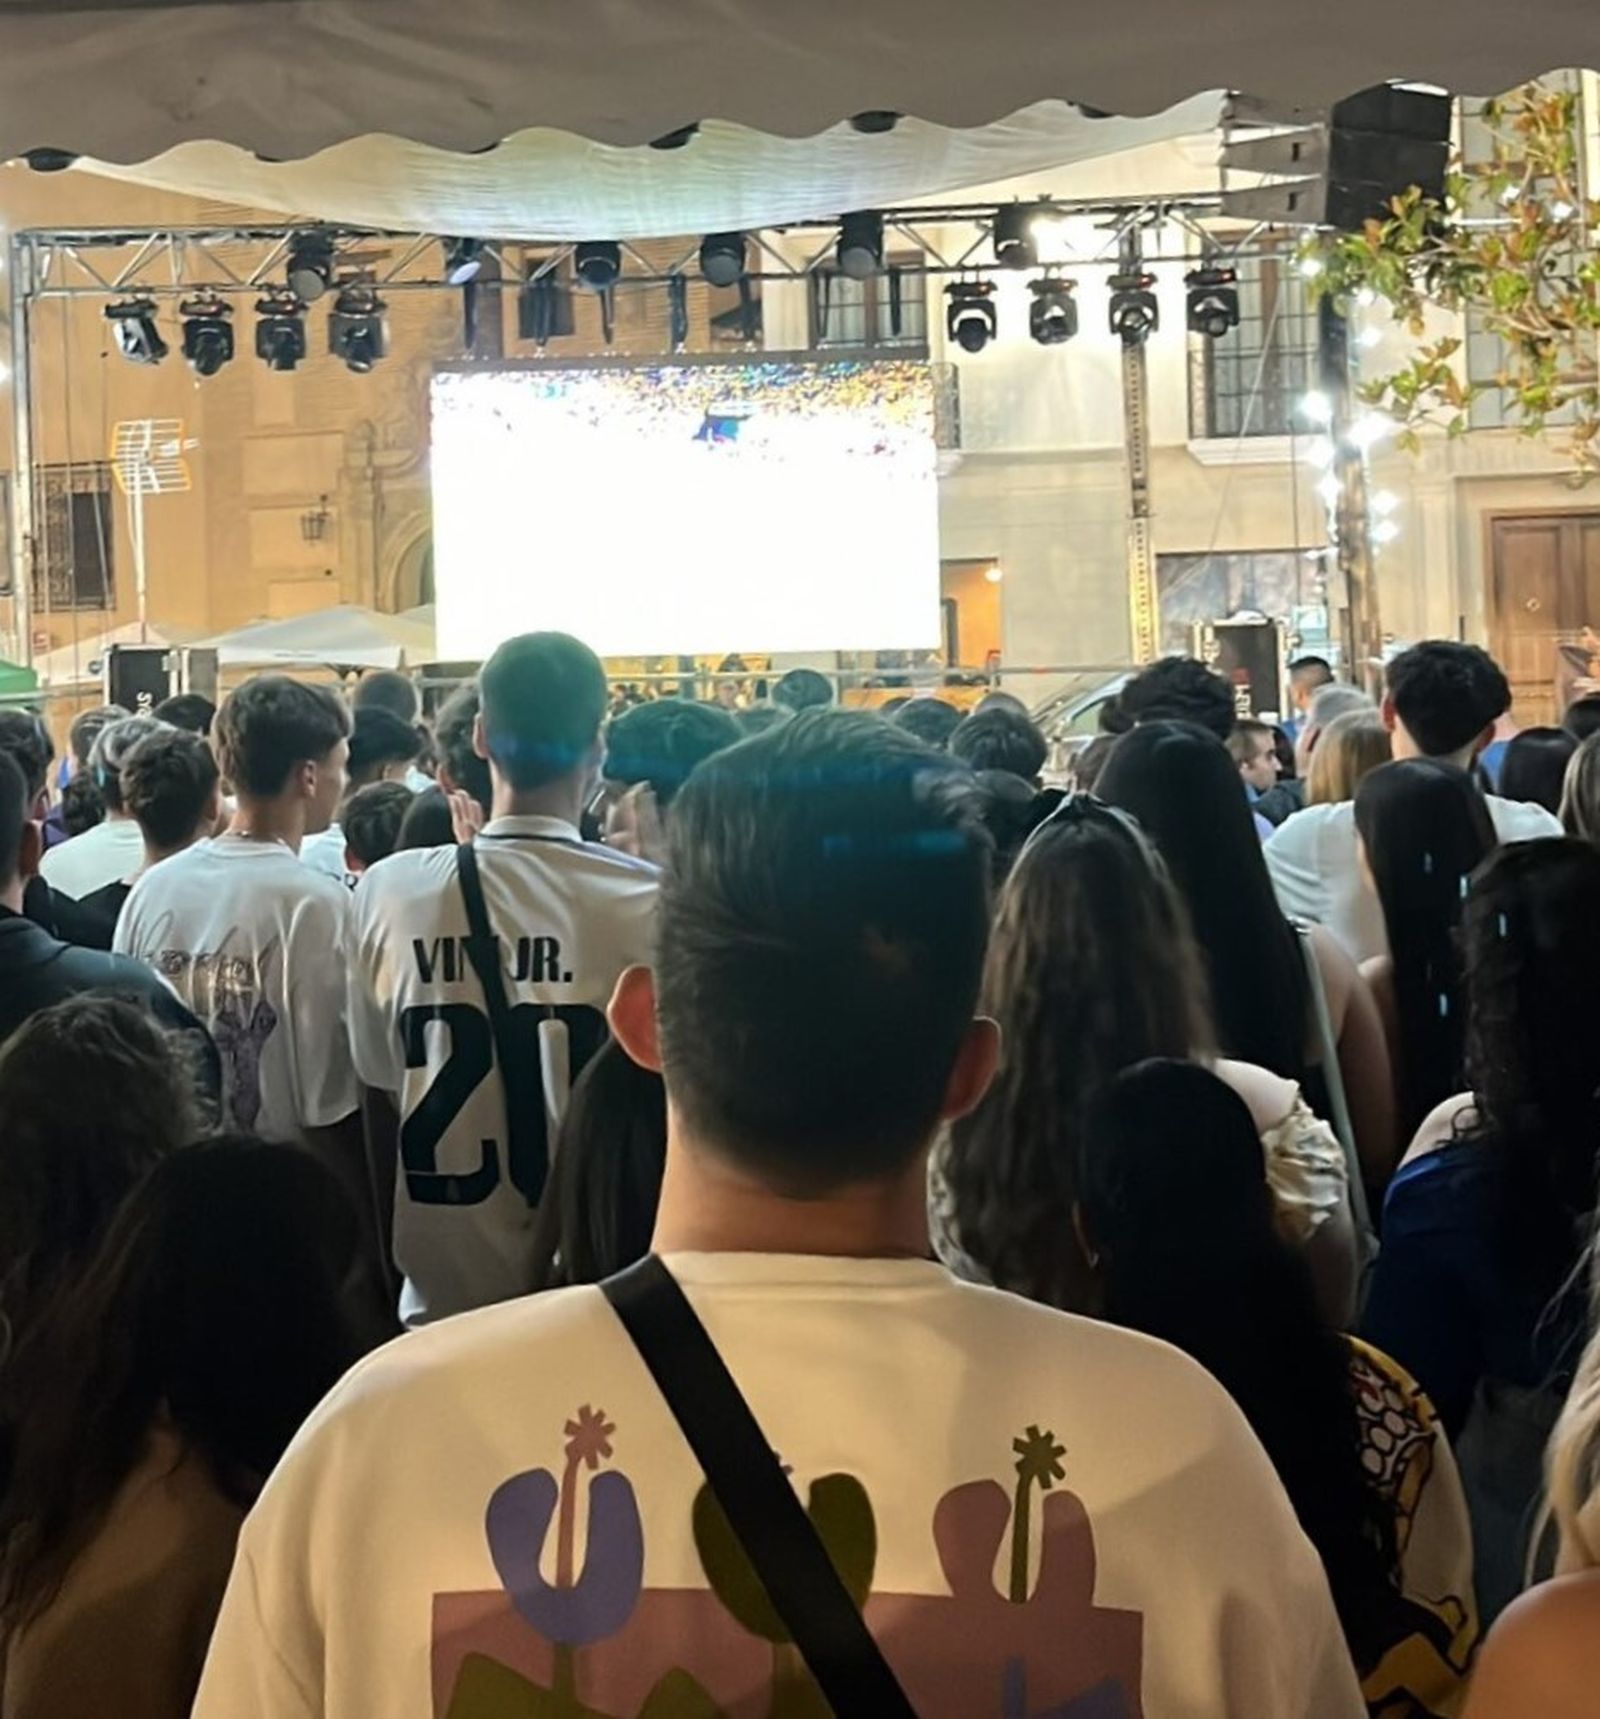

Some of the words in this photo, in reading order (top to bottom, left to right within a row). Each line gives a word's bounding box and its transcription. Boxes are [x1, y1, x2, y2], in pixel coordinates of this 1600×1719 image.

[412, 936, 499, 984] VI
[504, 936, 574, 983] JR.
[400, 1003, 609, 1207] 20
